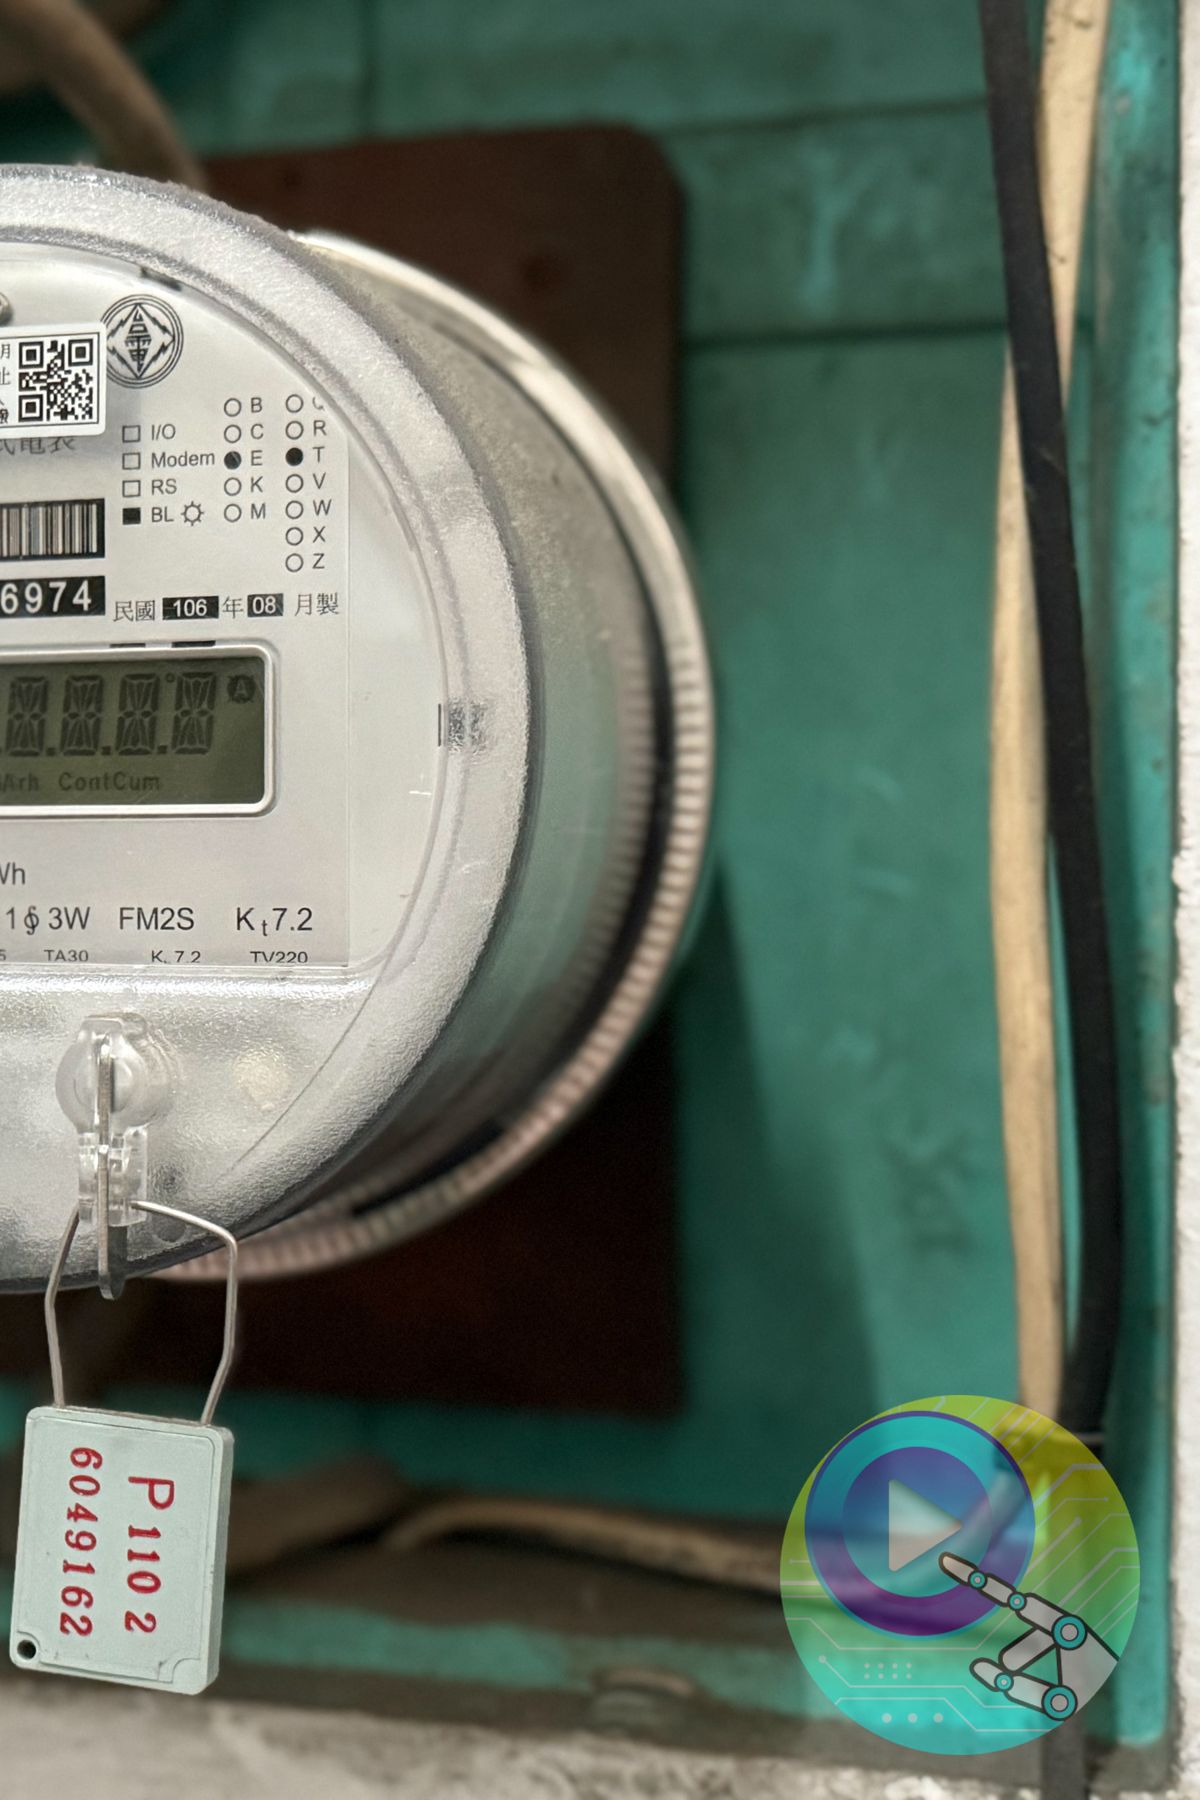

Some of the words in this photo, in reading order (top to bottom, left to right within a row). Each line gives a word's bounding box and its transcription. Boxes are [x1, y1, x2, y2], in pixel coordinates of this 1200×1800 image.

[250, 397, 263, 413] B
[250, 423, 264, 440] C
[313, 420, 327, 437] R
[151, 452, 216, 469] Modem
[250, 450, 263, 466] E
[312, 446, 326, 463] T
[151, 478, 177, 495] RS
[250, 476, 264, 493] K
[312, 473, 326, 489] V
[151, 506, 174, 523] BL
[250, 503, 266, 519] M
[312, 499, 332, 516] W
[312, 526, 326, 543] X
[312, 553, 325, 569] Z
[113, 600, 156, 622] 民國
[172, 597, 207, 617] 106
[222, 595, 244, 619] 年
[251, 595, 276, 615] 08
[119, 906, 195, 931] FM2S
[43, 949, 89, 963] TA30
[250, 951, 309, 964] TV220
[59, 1447, 103, 1637] 6049162
